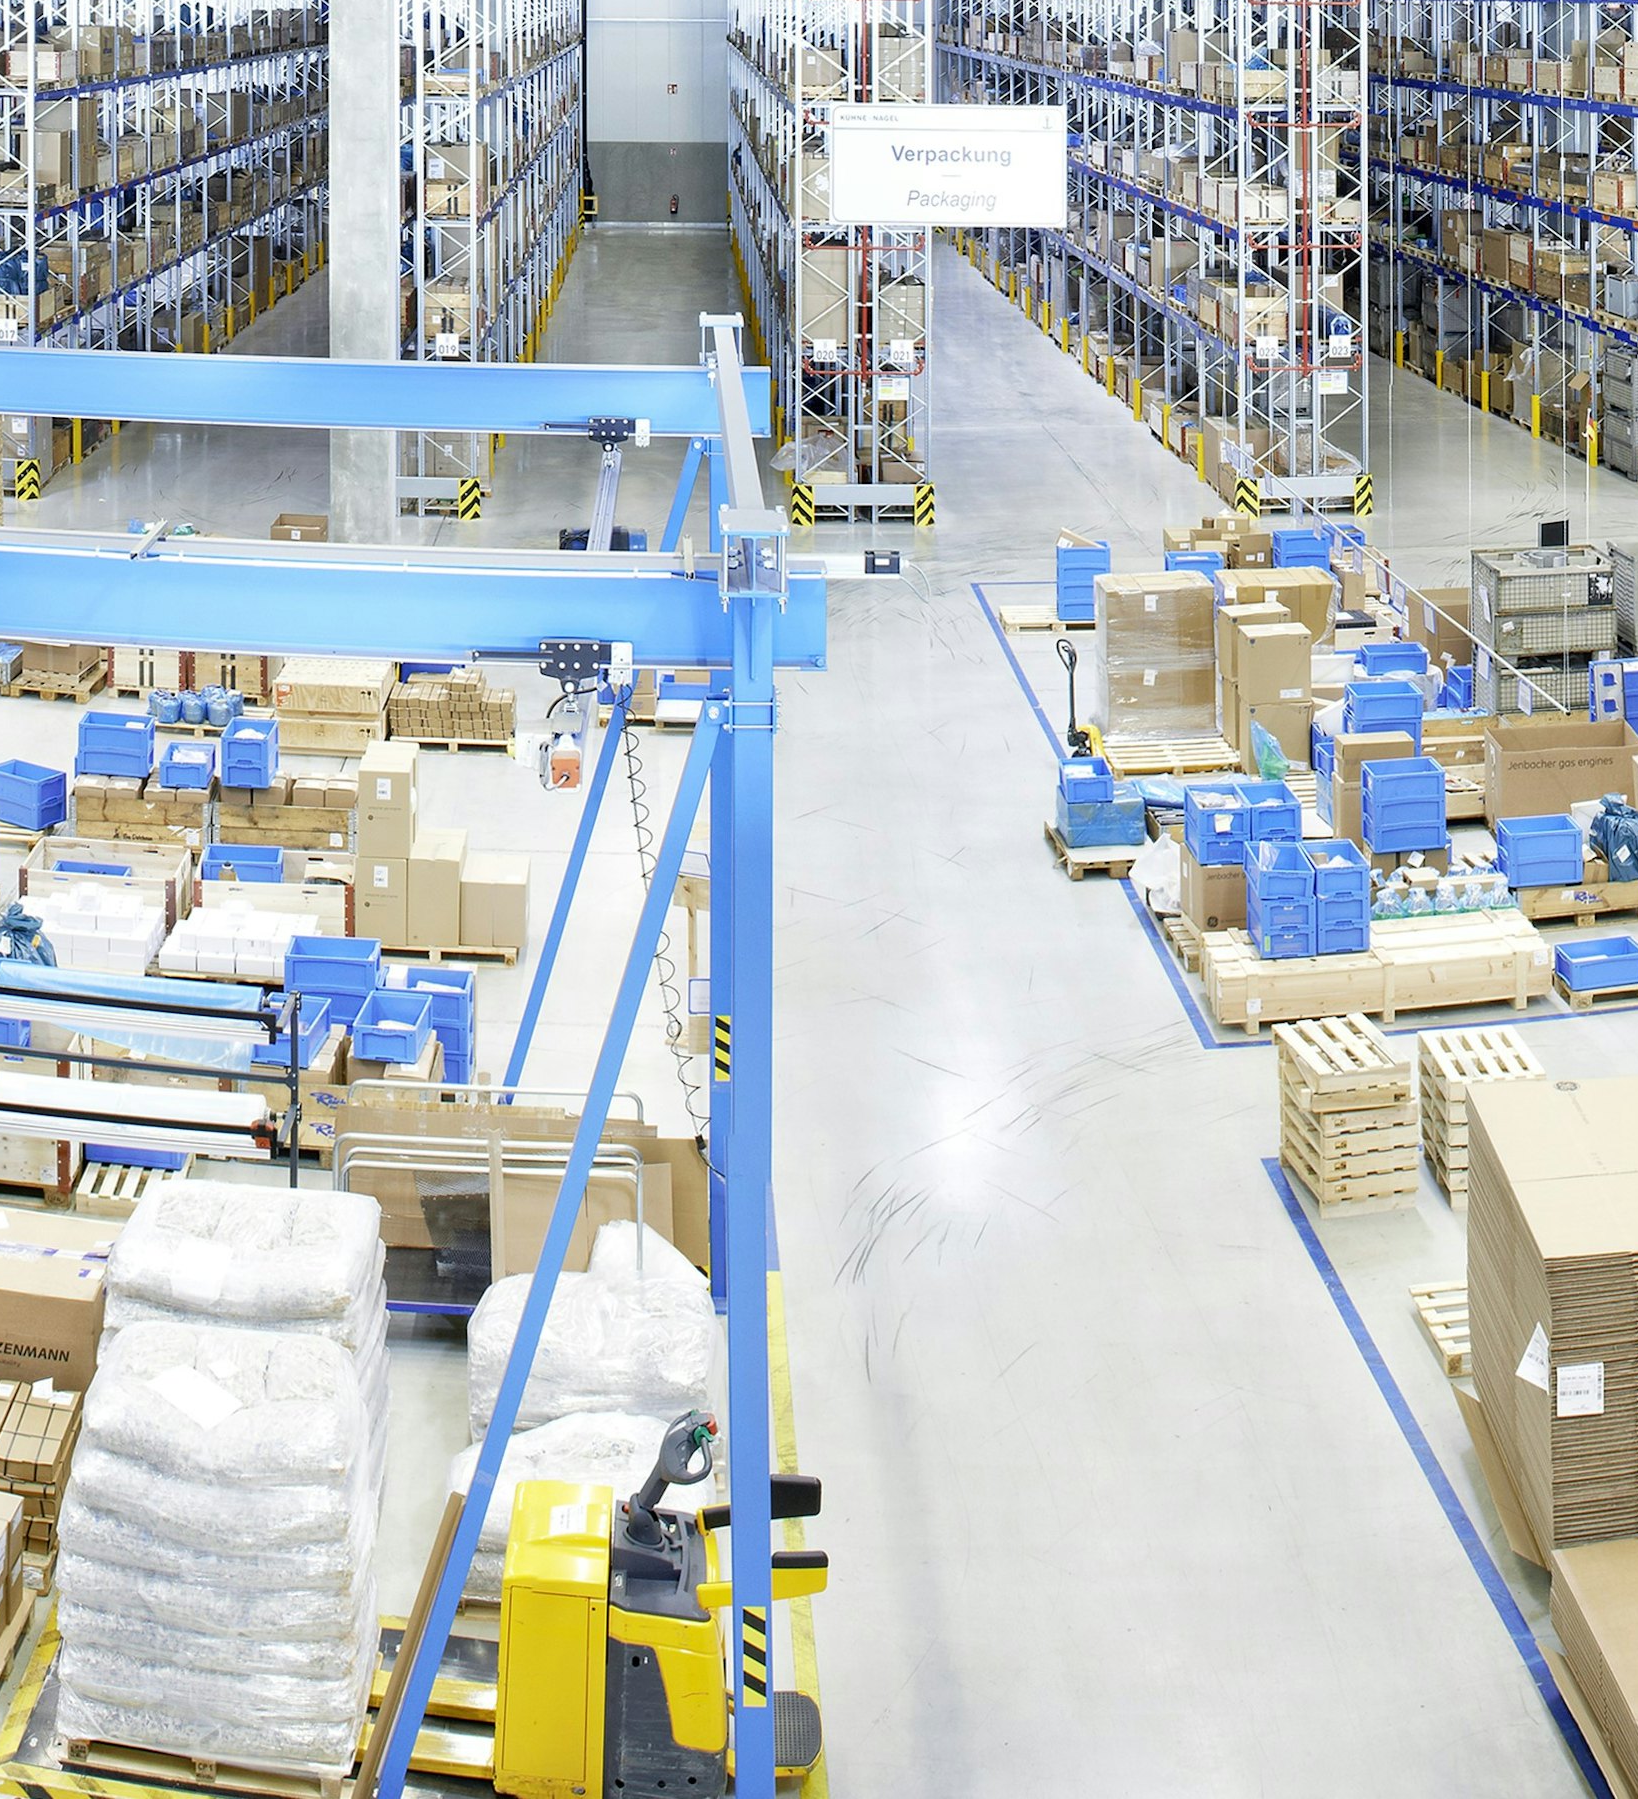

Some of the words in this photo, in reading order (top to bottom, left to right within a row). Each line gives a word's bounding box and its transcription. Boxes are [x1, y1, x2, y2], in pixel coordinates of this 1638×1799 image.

[891, 145, 1011, 166] Verpackung
[907, 190, 997, 211] Packaging
[0, 330, 15, 339] 017
[439, 344, 457, 354] 019
[1259, 348, 1276, 357] 022
[1331, 346, 1349, 356] 023
[817, 350, 835, 360] 020
[893, 350, 910, 360] 021
[1508, 758, 1556, 771] Jenbacher
[1559, 760, 1575, 770] gas
[1577, 756, 1613, 768] engines
[1206, 872, 1240, 880] Jenbacher
